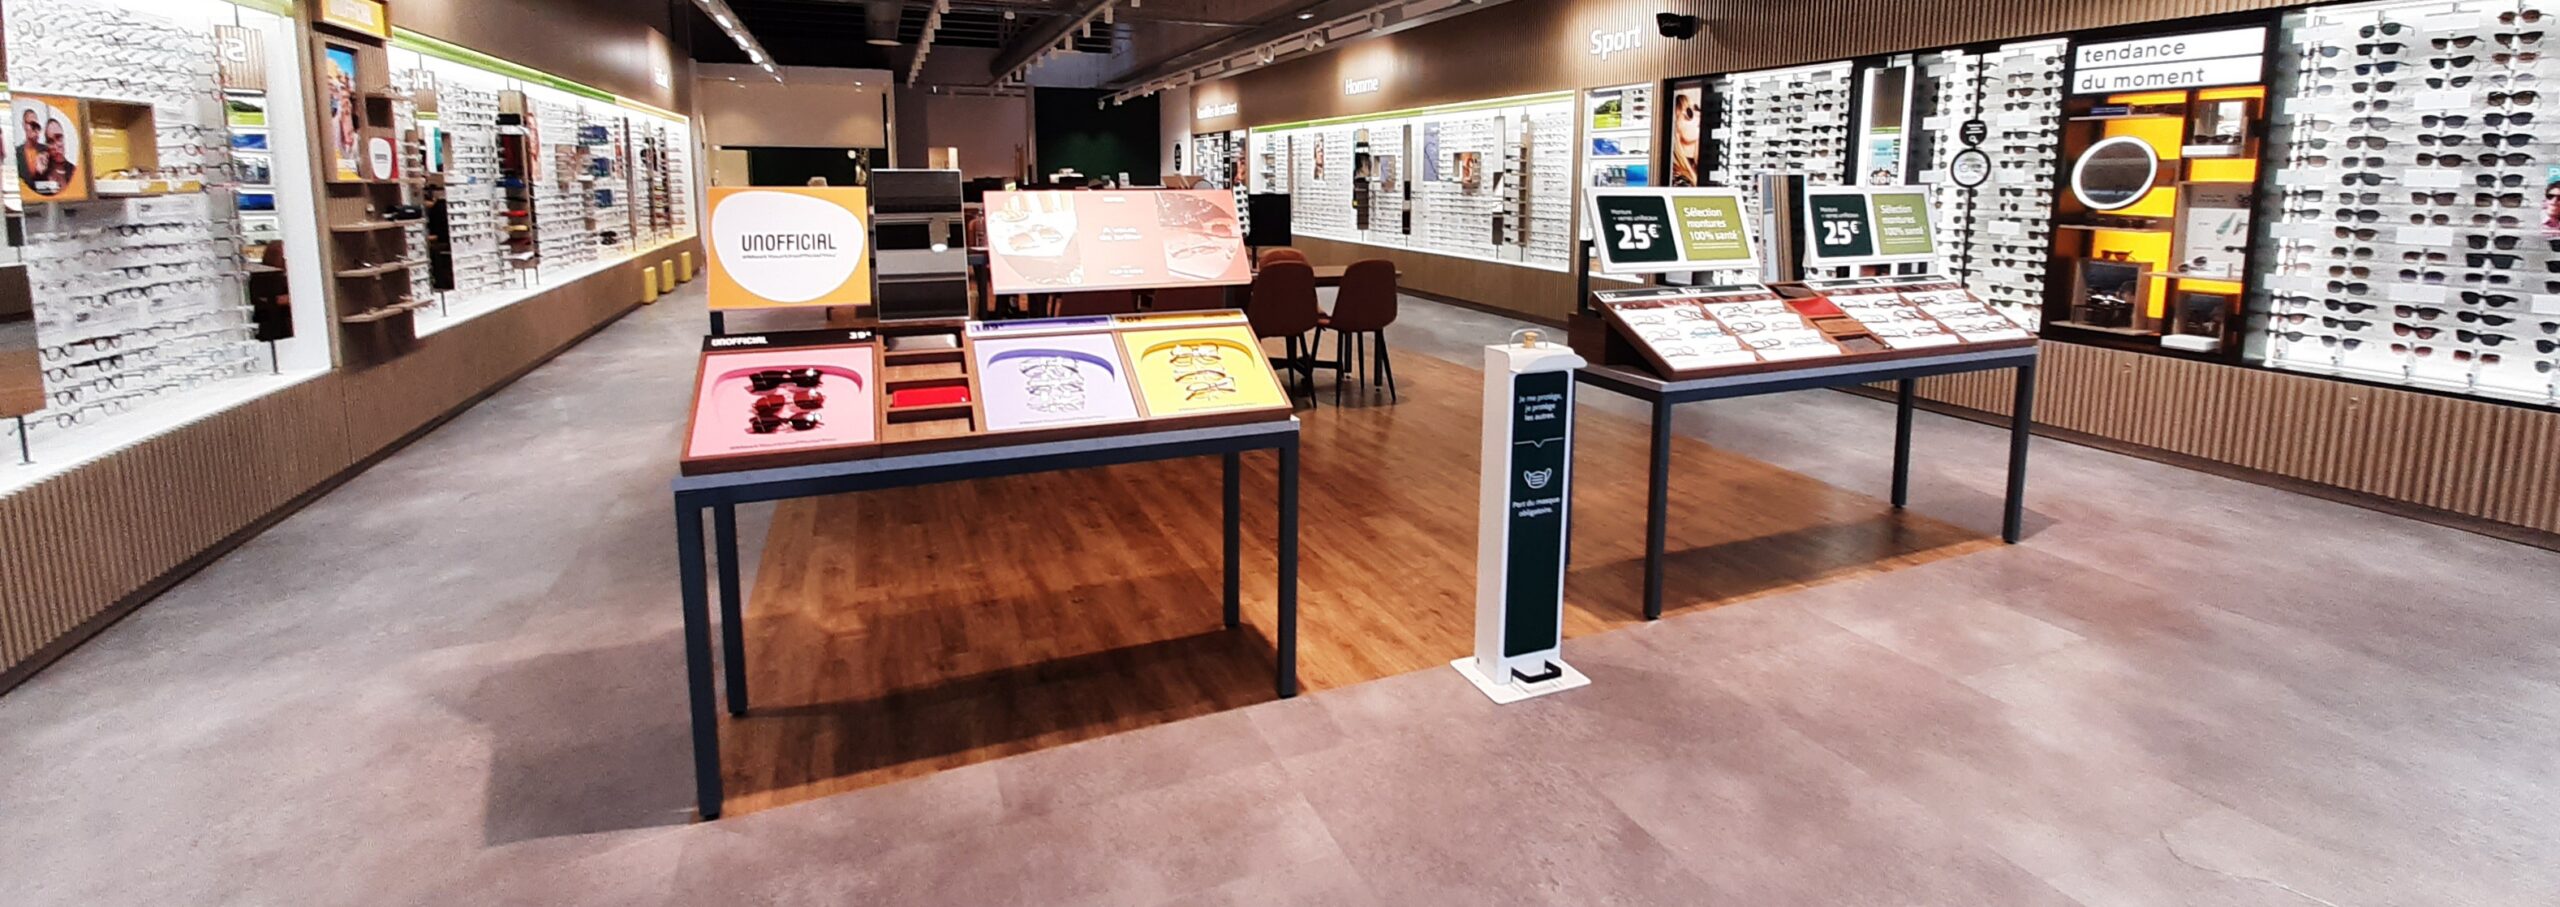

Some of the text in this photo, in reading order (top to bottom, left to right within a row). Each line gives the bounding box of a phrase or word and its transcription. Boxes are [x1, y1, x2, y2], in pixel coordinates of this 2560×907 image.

[1590, 26, 1641, 61] Sport
[2084, 42, 2186, 63] tendance
[1345, 78, 1380, 95] Homme
[2081, 67, 2205, 90] du moment
[1683, 207, 1723, 217] Sélection
[1686, 219, 1727, 228] montures
[1822, 221, 1860, 245] 25€
[741, 233, 837, 252] UNOFFICIAL
[1615, 223, 1660, 250] 25€
[1689, 231, 1714, 241] 100%
[711, 336, 768, 347] UNOFFICIAL
